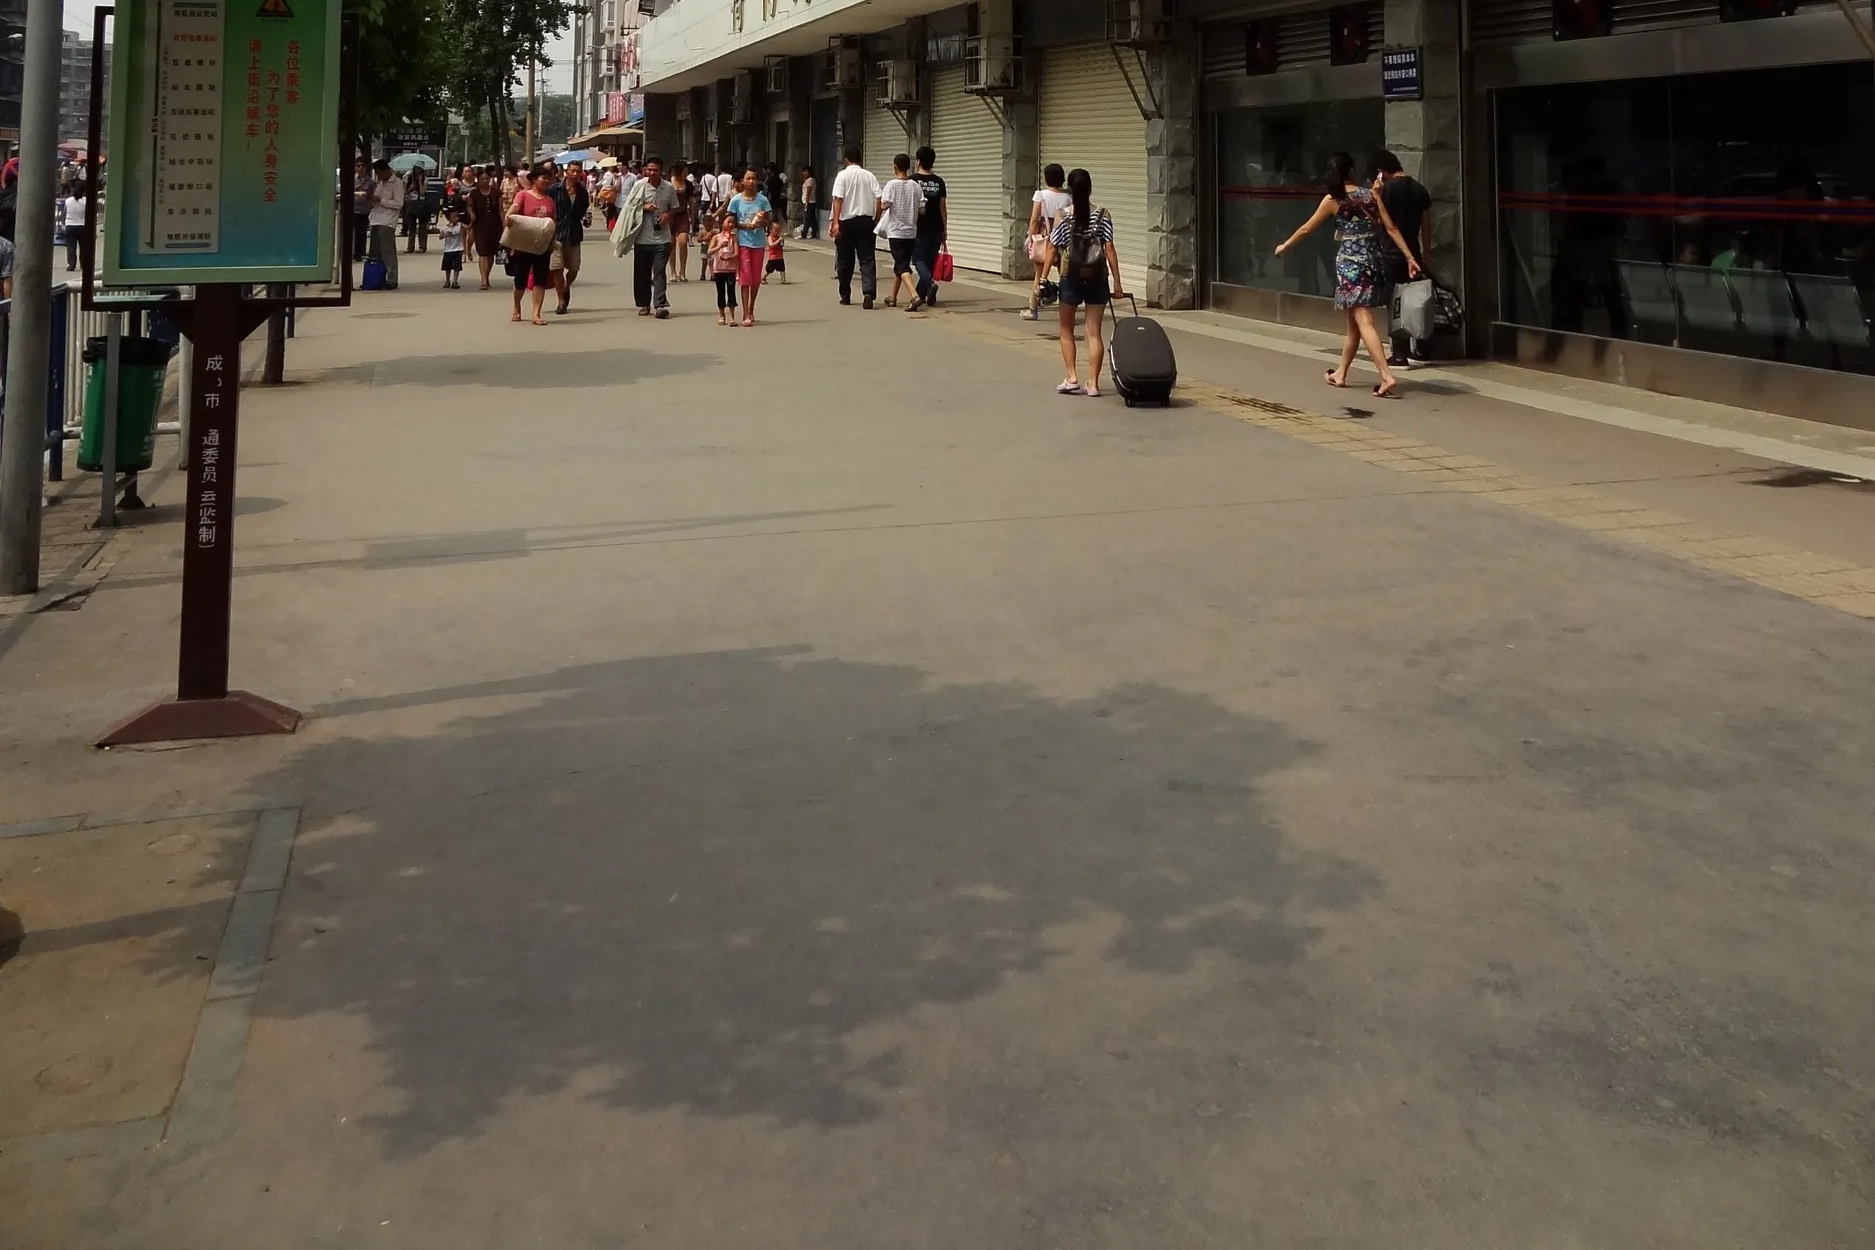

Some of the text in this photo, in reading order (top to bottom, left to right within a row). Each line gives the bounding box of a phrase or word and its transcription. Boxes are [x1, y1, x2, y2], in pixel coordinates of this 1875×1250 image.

[264, 70, 280, 203] 为了您的人身安全
